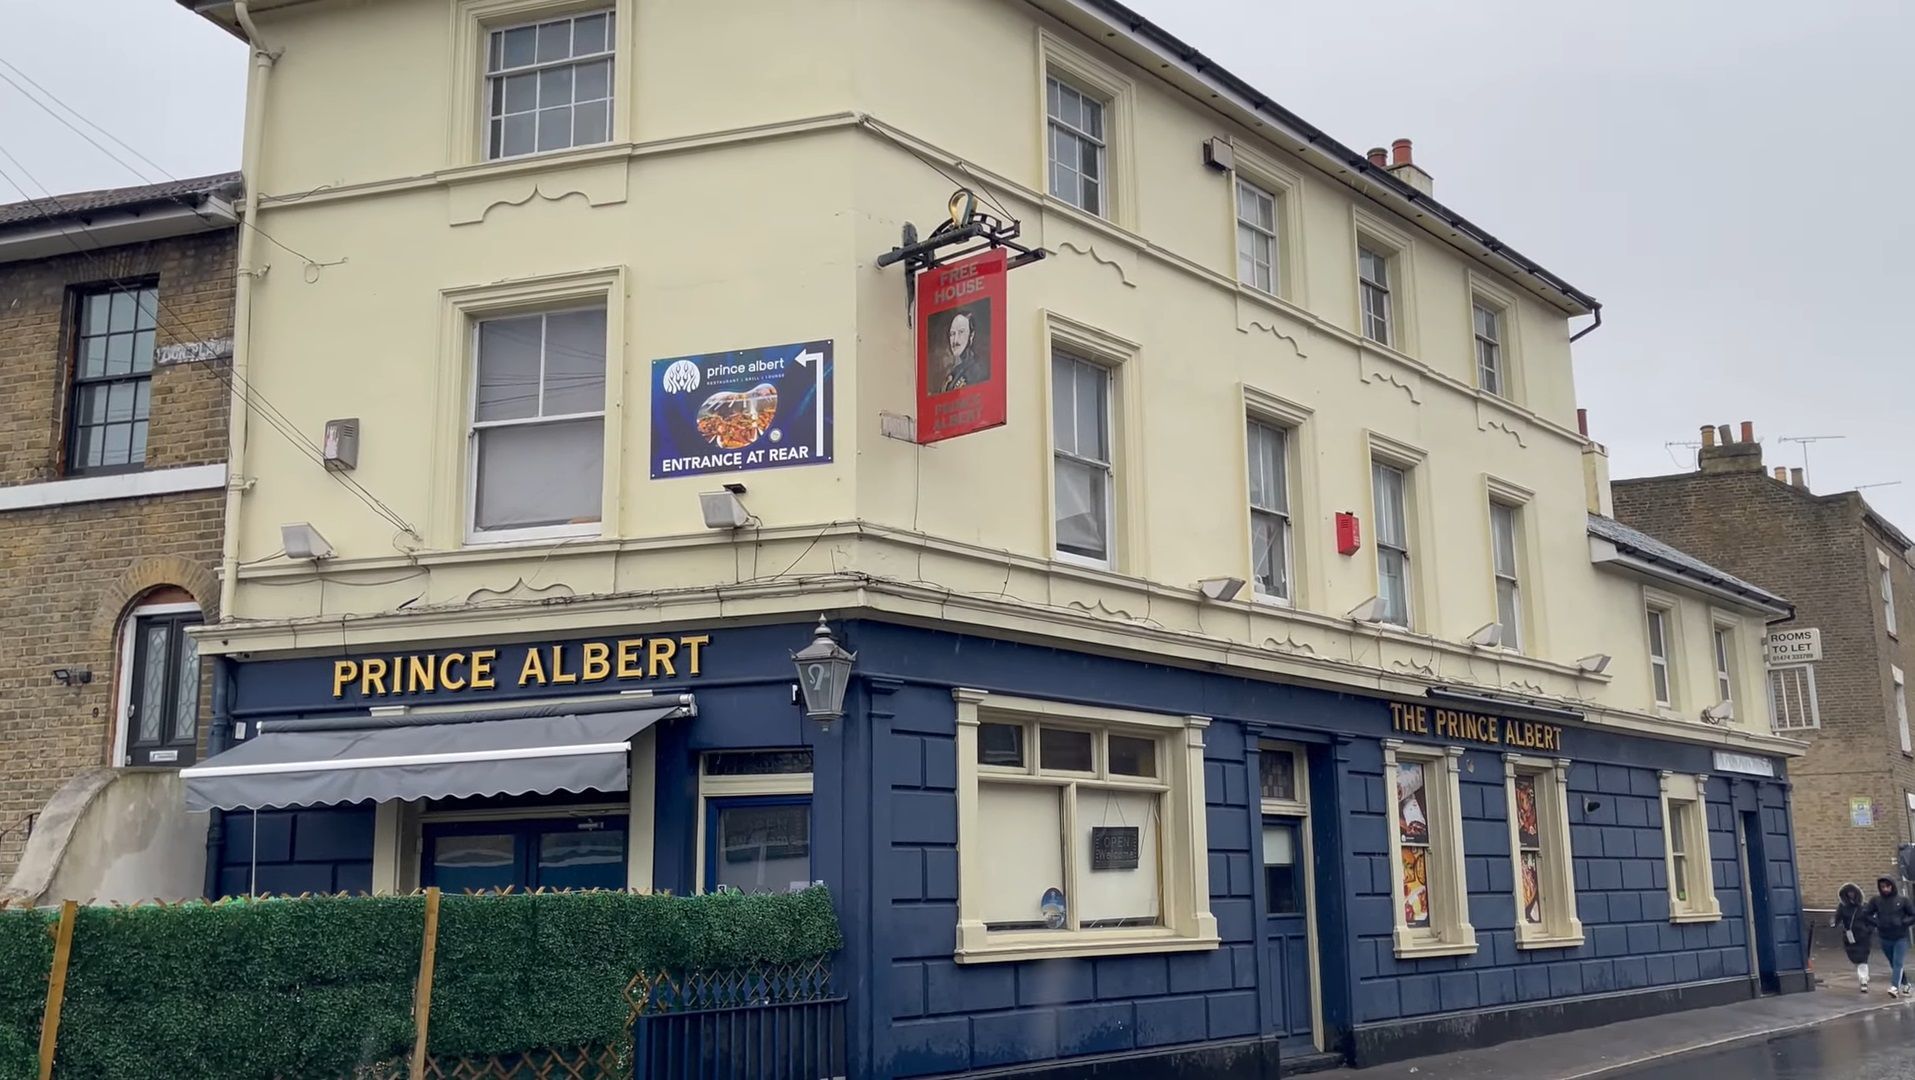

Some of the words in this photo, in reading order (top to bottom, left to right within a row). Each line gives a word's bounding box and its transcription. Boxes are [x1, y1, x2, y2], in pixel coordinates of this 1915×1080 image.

[940, 261, 978, 286] FREE
[934, 275, 985, 304] HOUSE
[706, 364, 745, 379] prince
[748, 357, 784, 372] albert
[662, 452, 742, 472] ENTRANCE
[747, 450, 765, 464] AT
[769, 445, 809, 461] REAR
[1771, 631, 1811, 642] ROOMS
[1772, 645, 1788, 653] TO
[1791, 643, 1812, 652] LET
[332, 648, 497, 698] PRINCE
[518, 634, 710, 687] ALBERT
[1390, 702, 1428, 734] THE
[1435, 709, 1499, 743] PRINCE
[1505, 719, 1562, 750] ALBERT
[1103, 836, 1130, 848] OPEN
